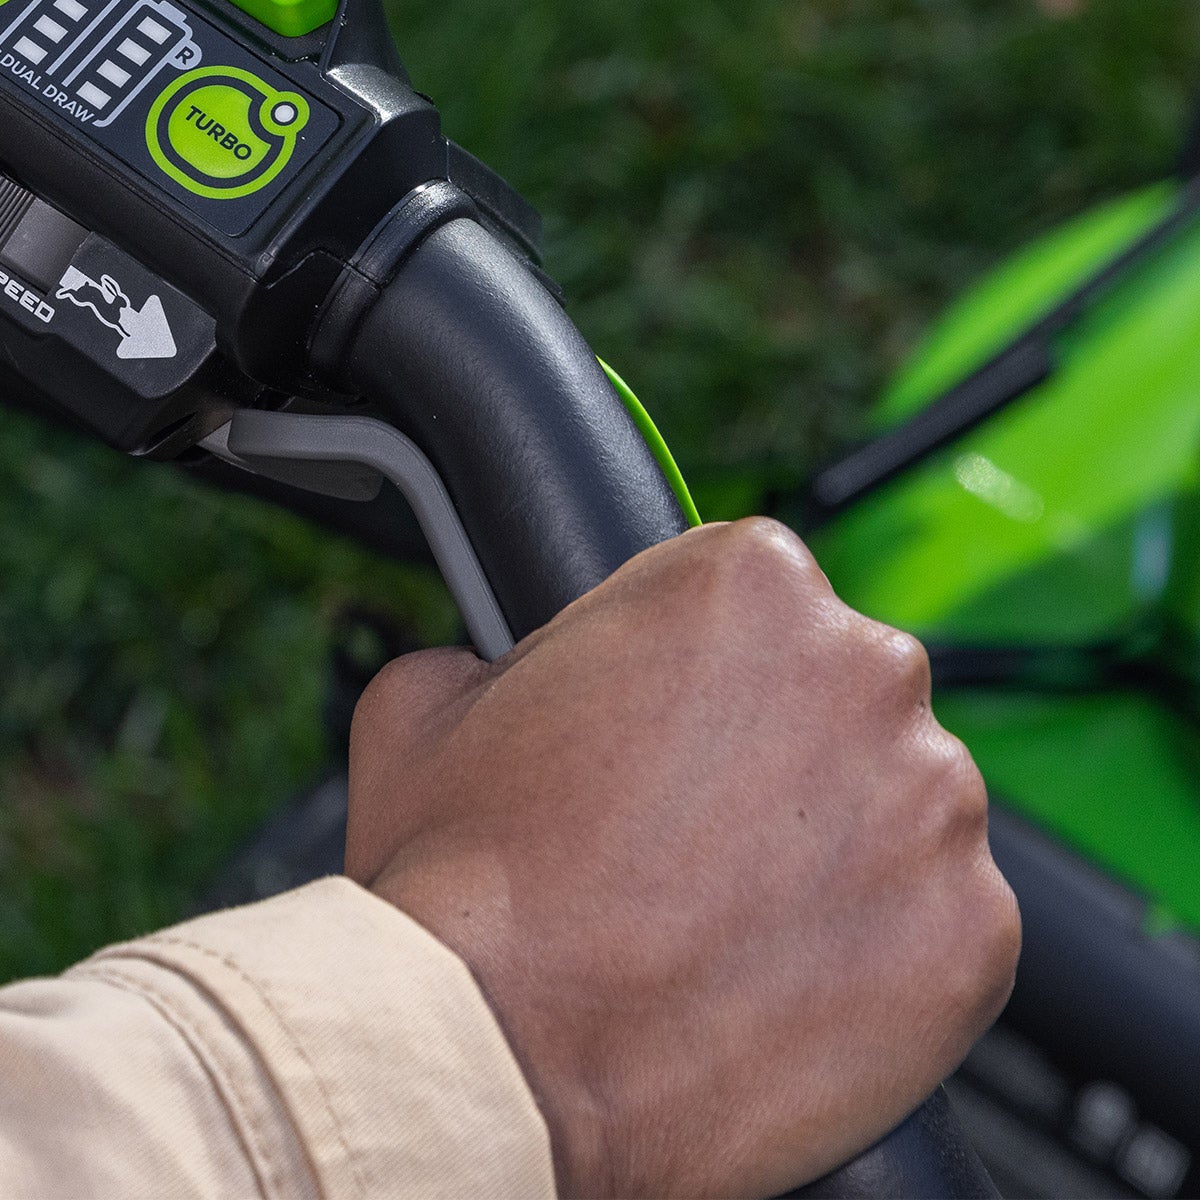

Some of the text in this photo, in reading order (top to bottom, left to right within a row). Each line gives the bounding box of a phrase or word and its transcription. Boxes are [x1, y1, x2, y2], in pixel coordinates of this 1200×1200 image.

[175, 46, 194, 65] R
[0, 53, 95, 123] DUAL DRAW
[185, 105, 252, 160] TURBO
